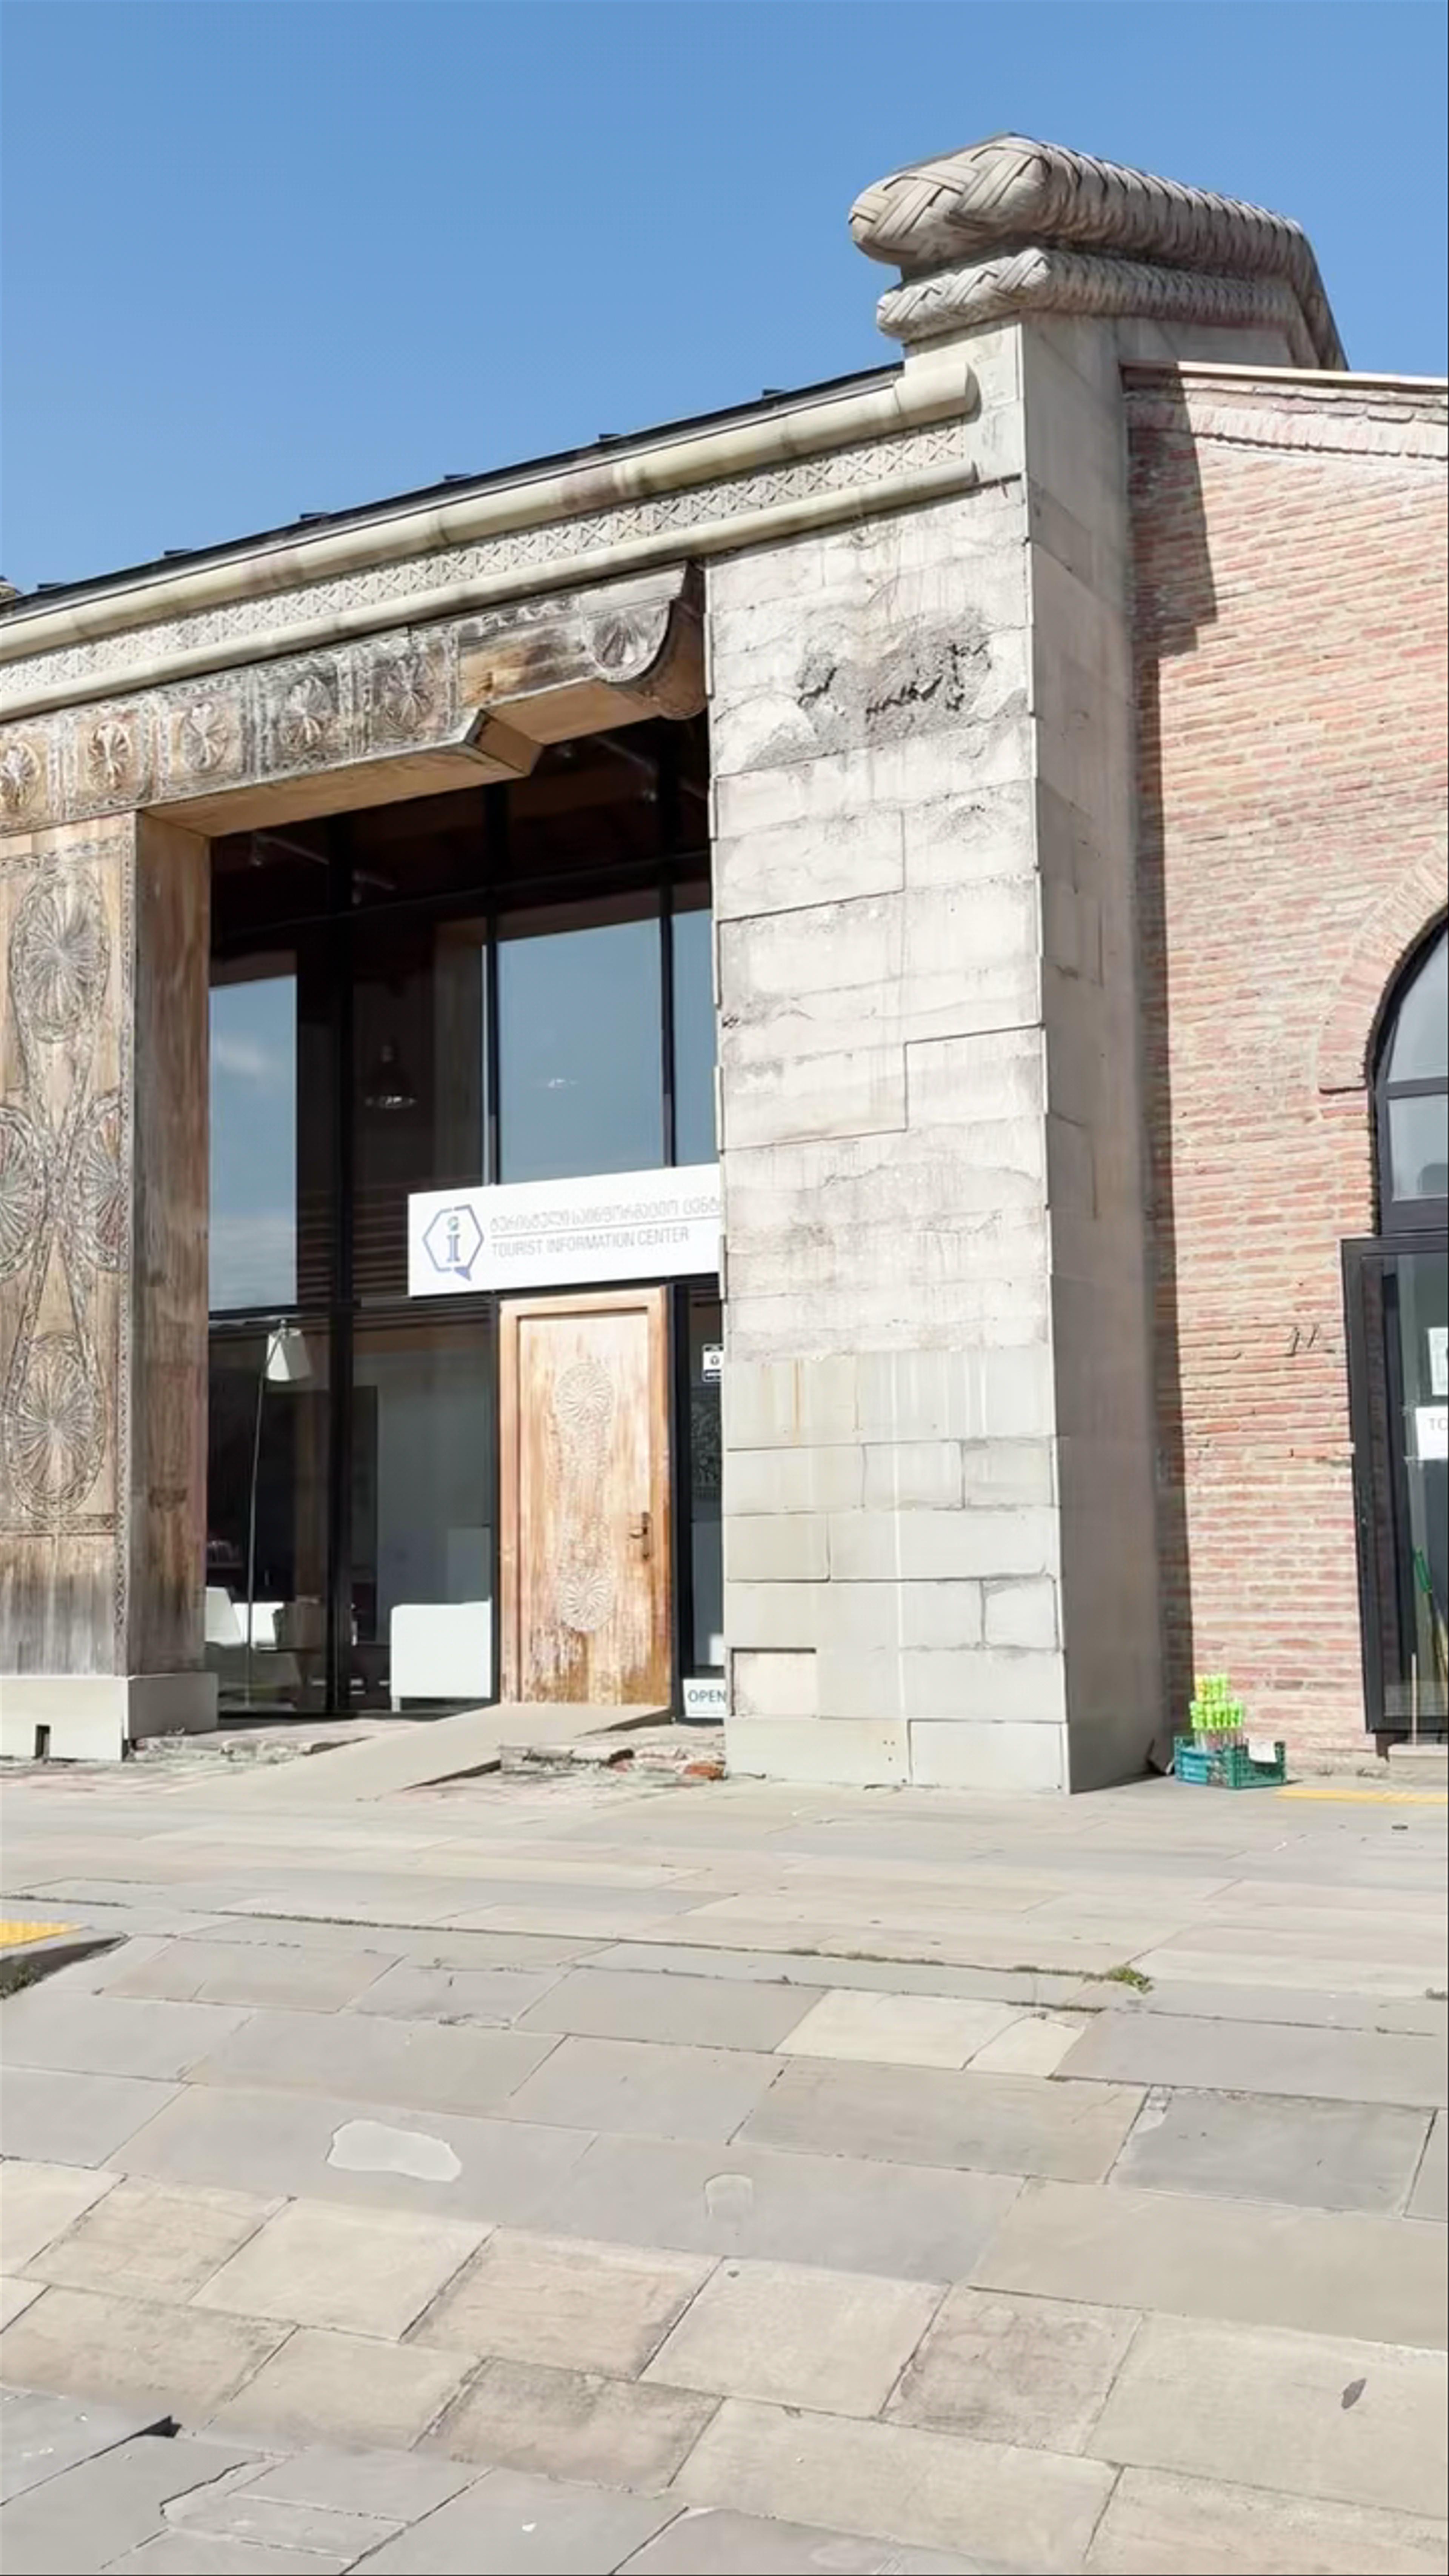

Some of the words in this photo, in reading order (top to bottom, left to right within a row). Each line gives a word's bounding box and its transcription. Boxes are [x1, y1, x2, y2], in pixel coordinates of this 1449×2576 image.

[491, 1239, 543, 1257] TOURIST
[547, 1231, 635, 1253] INFORMATION
[637, 1226, 689, 1246] CENTER
[688, 1689, 727, 1703] OPEN
